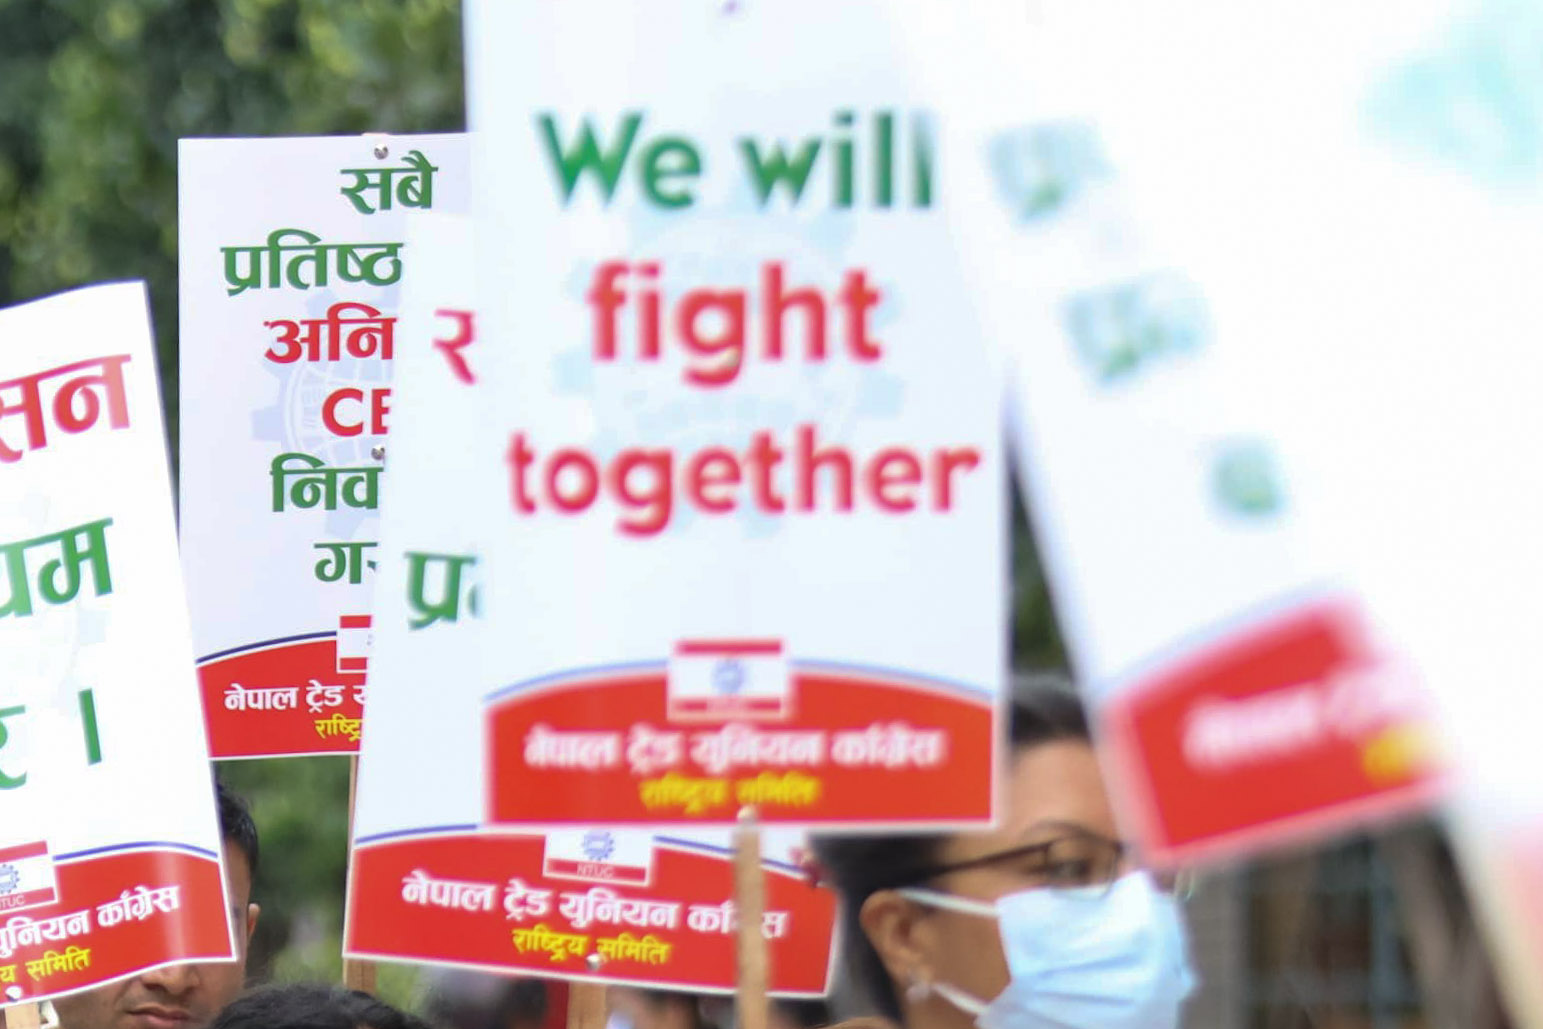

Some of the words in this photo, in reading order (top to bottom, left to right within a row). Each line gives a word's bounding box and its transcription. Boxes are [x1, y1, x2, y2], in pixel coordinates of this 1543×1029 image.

[340, 149, 438, 215] सबै
[539, 110, 705, 212] We
[739, 110, 937, 211] will
[263, 302, 399, 364] अनि
[585, 258, 886, 391] fight
[504, 422, 984, 540] together
[223, 682, 299, 711] नेपाल
[305, 679, 346, 713] ट्रेड
[402, 869, 495, 912] नेपाल
[503, 878, 550, 922] ट्रेड
[559, 886, 679, 930] युनियन
[26, 946, 92, 982] समिति
